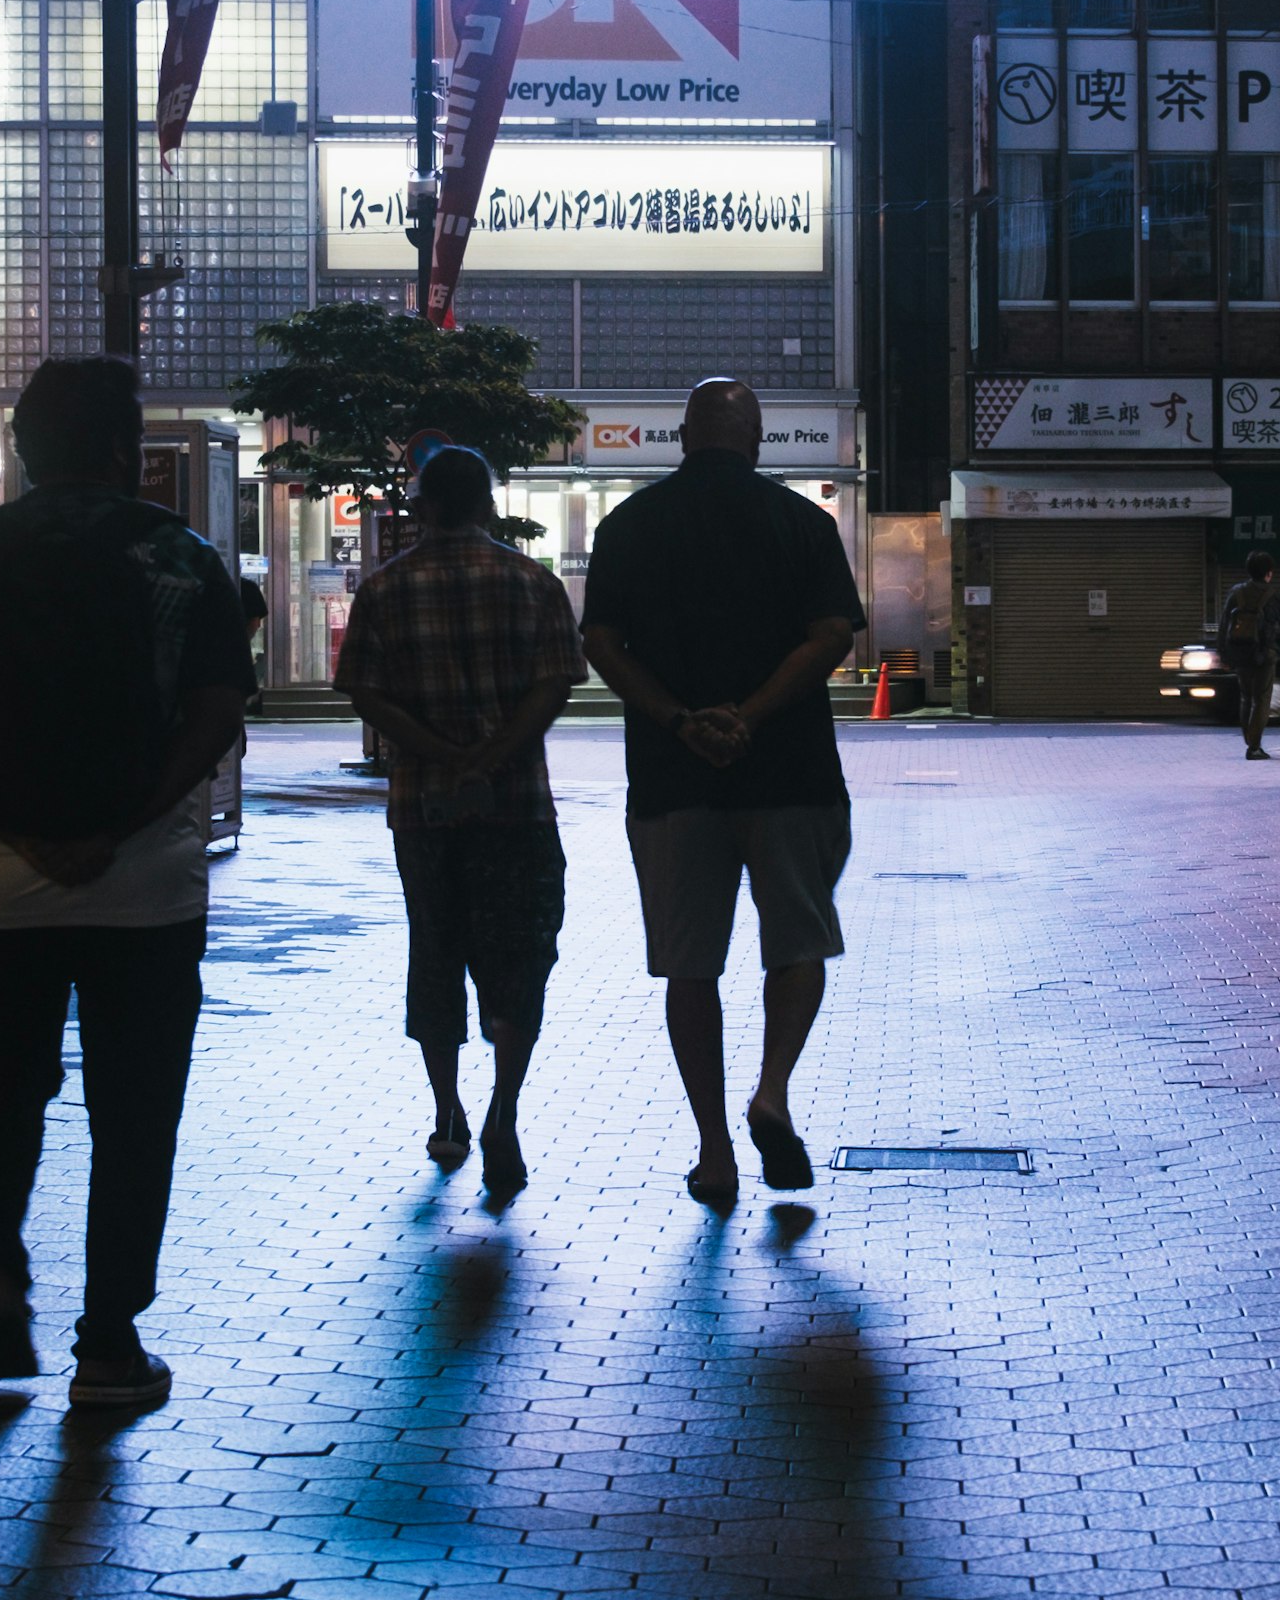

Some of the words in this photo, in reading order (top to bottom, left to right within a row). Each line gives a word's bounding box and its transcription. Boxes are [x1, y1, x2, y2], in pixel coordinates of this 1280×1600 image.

[506, 76, 607, 107] veryday
[617, 78, 670, 102] Low
[679, 78, 740, 103] Price
[1149, 391, 1203, 443] すし
[597, 424, 640, 447] OK
[794, 428, 830, 443] Price
